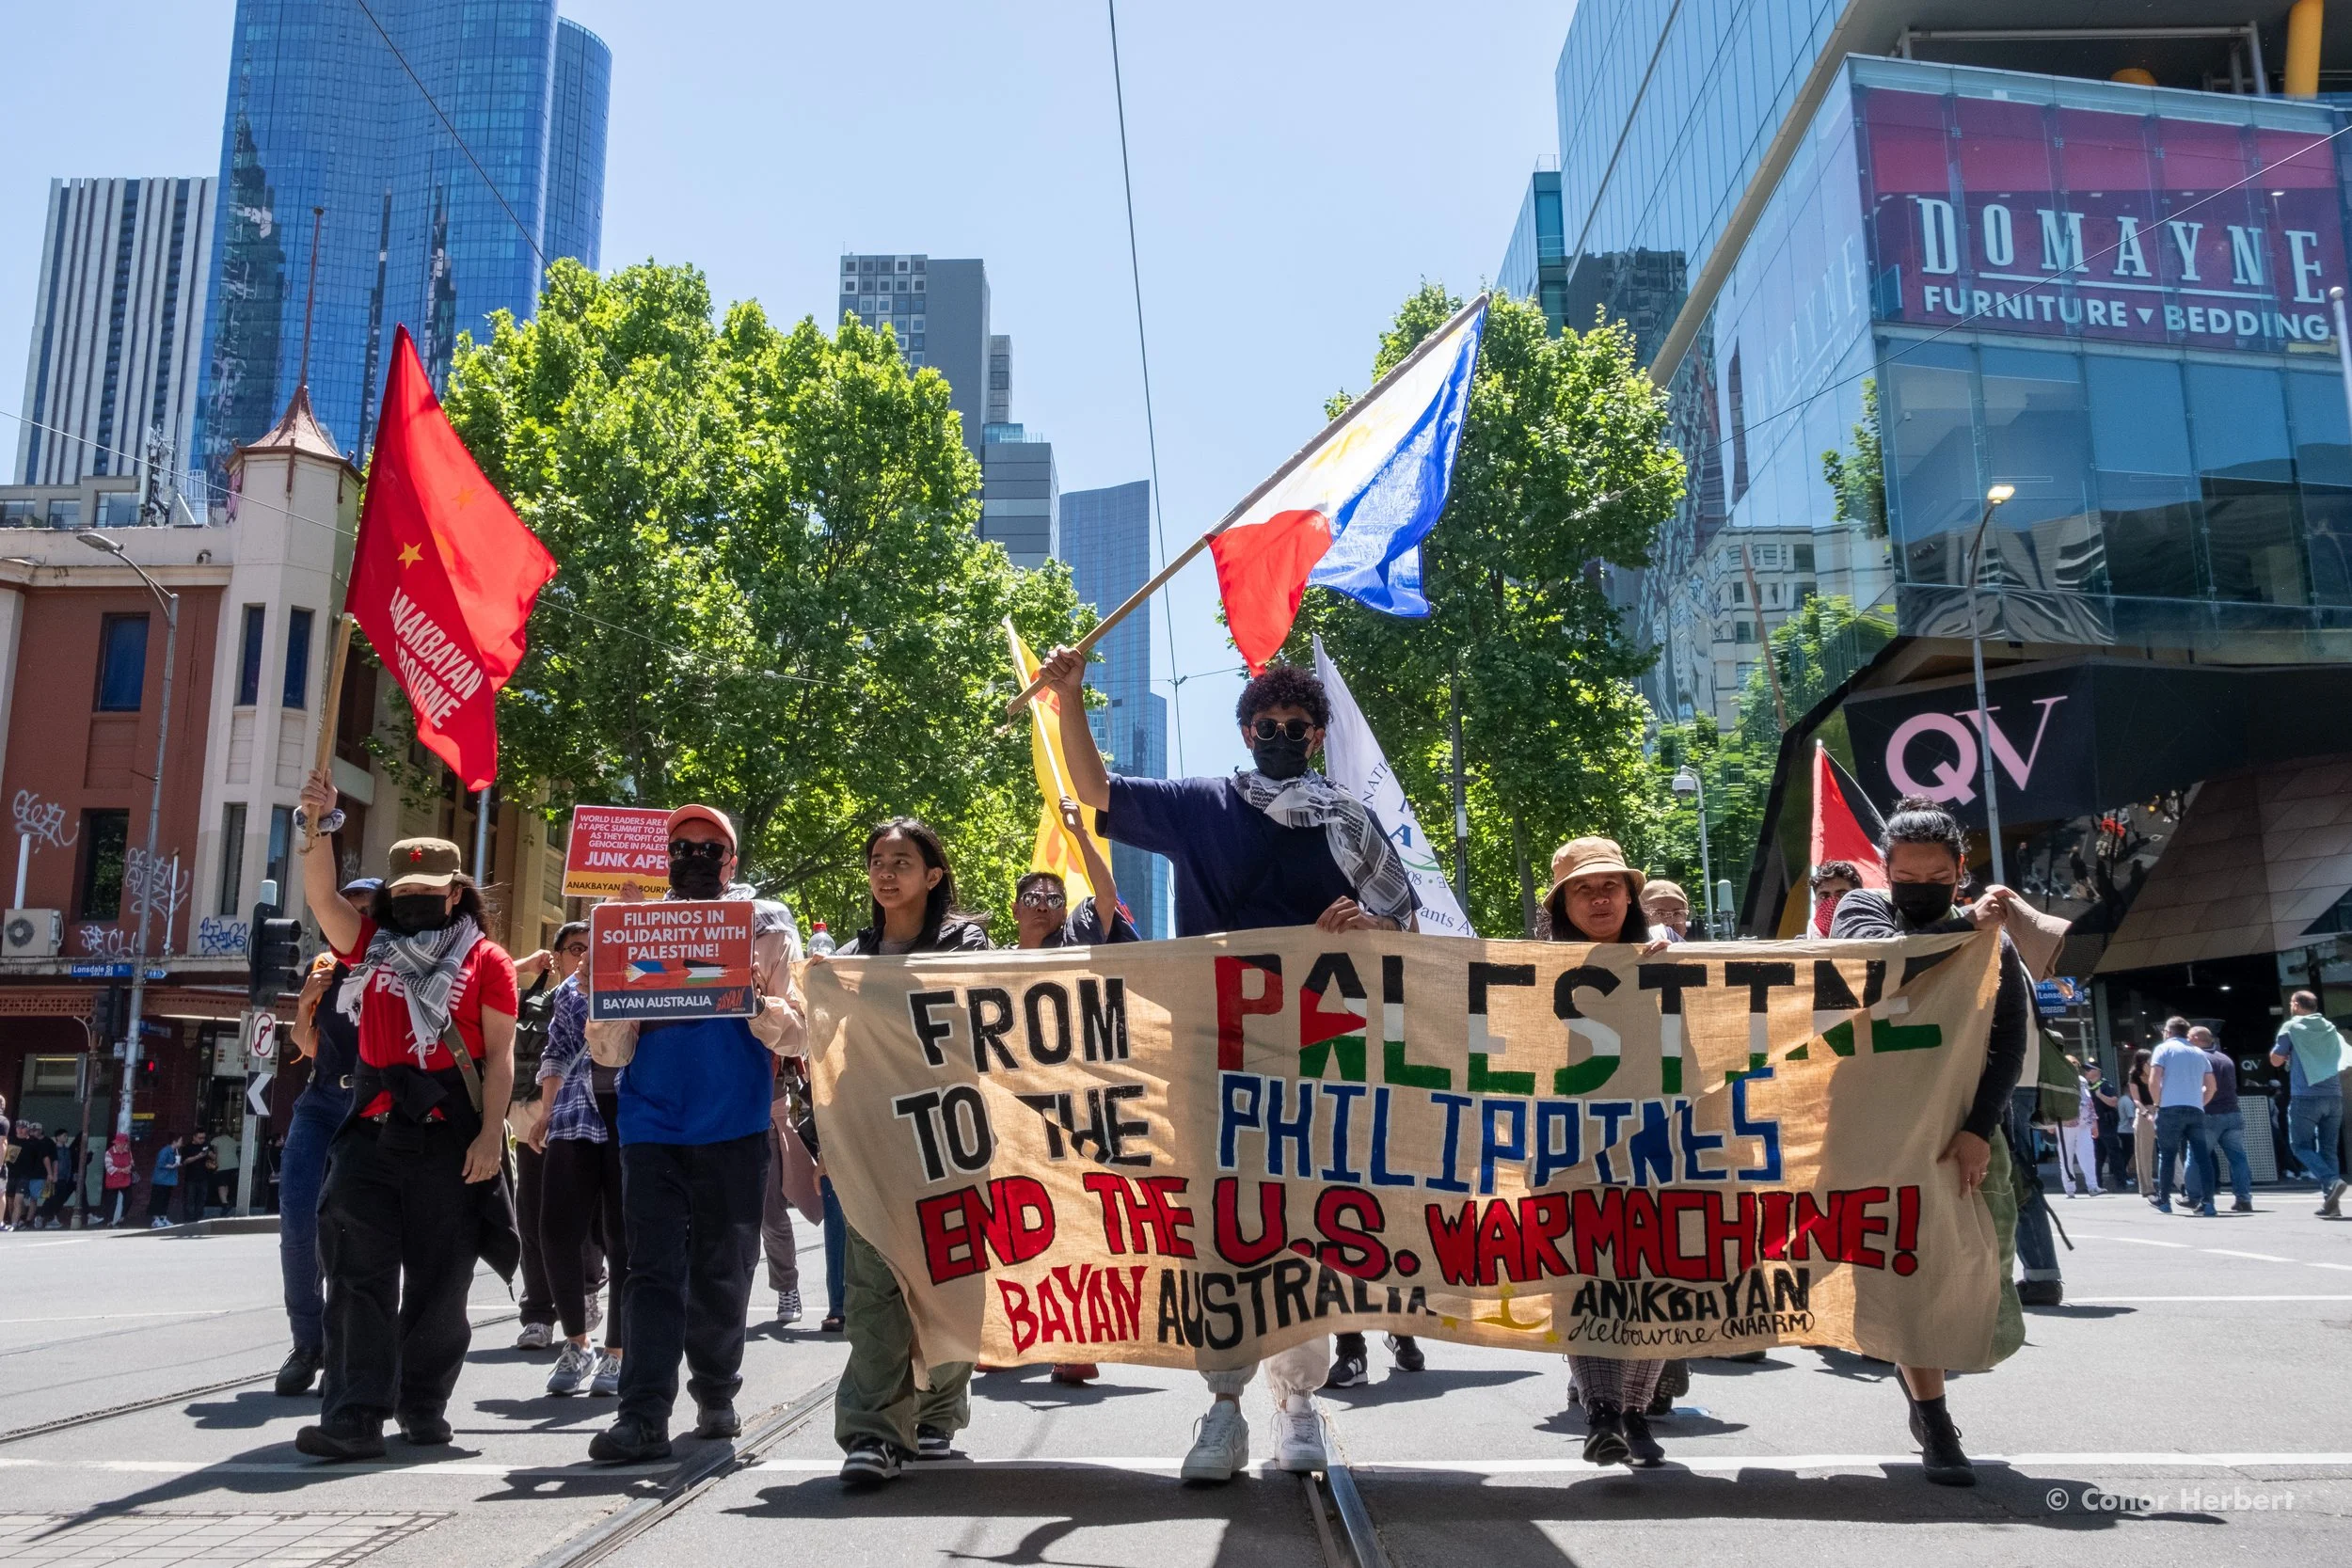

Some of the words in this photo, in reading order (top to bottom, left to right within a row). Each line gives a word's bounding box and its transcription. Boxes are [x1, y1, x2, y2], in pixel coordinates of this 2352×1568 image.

[1916, 198, 2326, 304] DOMAYNE
[1925, 286, 2128, 327] FURNITURE
[2166, 306, 2329, 341] BEDDING
[389, 586, 484, 701] ANAKBAYAN
[395, 639, 462, 730] BOURNE
[1885, 695, 2068, 806] QV
[580, 815, 610, 823] WORLD
[611, 816, 645, 826] LEADERS
[611, 825, 643, 833] SUMMIT
[588, 840, 629, 849] GENOCIDE
[640, 843, 669, 851] PALEST
[624, 833, 652, 842] PROFIT
[584, 851, 631, 868] JUNK
[566, 881, 621, 892] ANAKBAYAN
[624, 911, 703, 927] FILIPINOS
[707, 910, 724, 923] IN
[602, 927, 701, 944] SOLIDARITY
[703, 926, 746, 941] WITH
[628, 942, 720, 960] PALESTINE!
[602, 998, 650, 1010] BAYAN
[648, 994, 712, 1008] AUSTRALIA
[907, 976, 1131, 1075] FROM
[1215, 942, 1964, 1097] PALESTINE
[2241, 1059, 2262, 1070] QV
[892, 1082, 995, 1184] TO
[1014, 1084, 1153, 1167] THE
[1216, 1066, 1784, 1196] PHILIPPINES
[915, 1172, 1057, 1286] END
[1081, 1171, 1198, 1260] THE
[1213, 1175, 1422, 1282] U.S.
[1570, 1267, 1811, 1323] ANAKBAYAN
[995, 1263, 1149, 1355] BAYAN
[1568, 1316, 1716, 1346] Melbourne
[1721, 1309, 1816, 1340] (NAARM)
